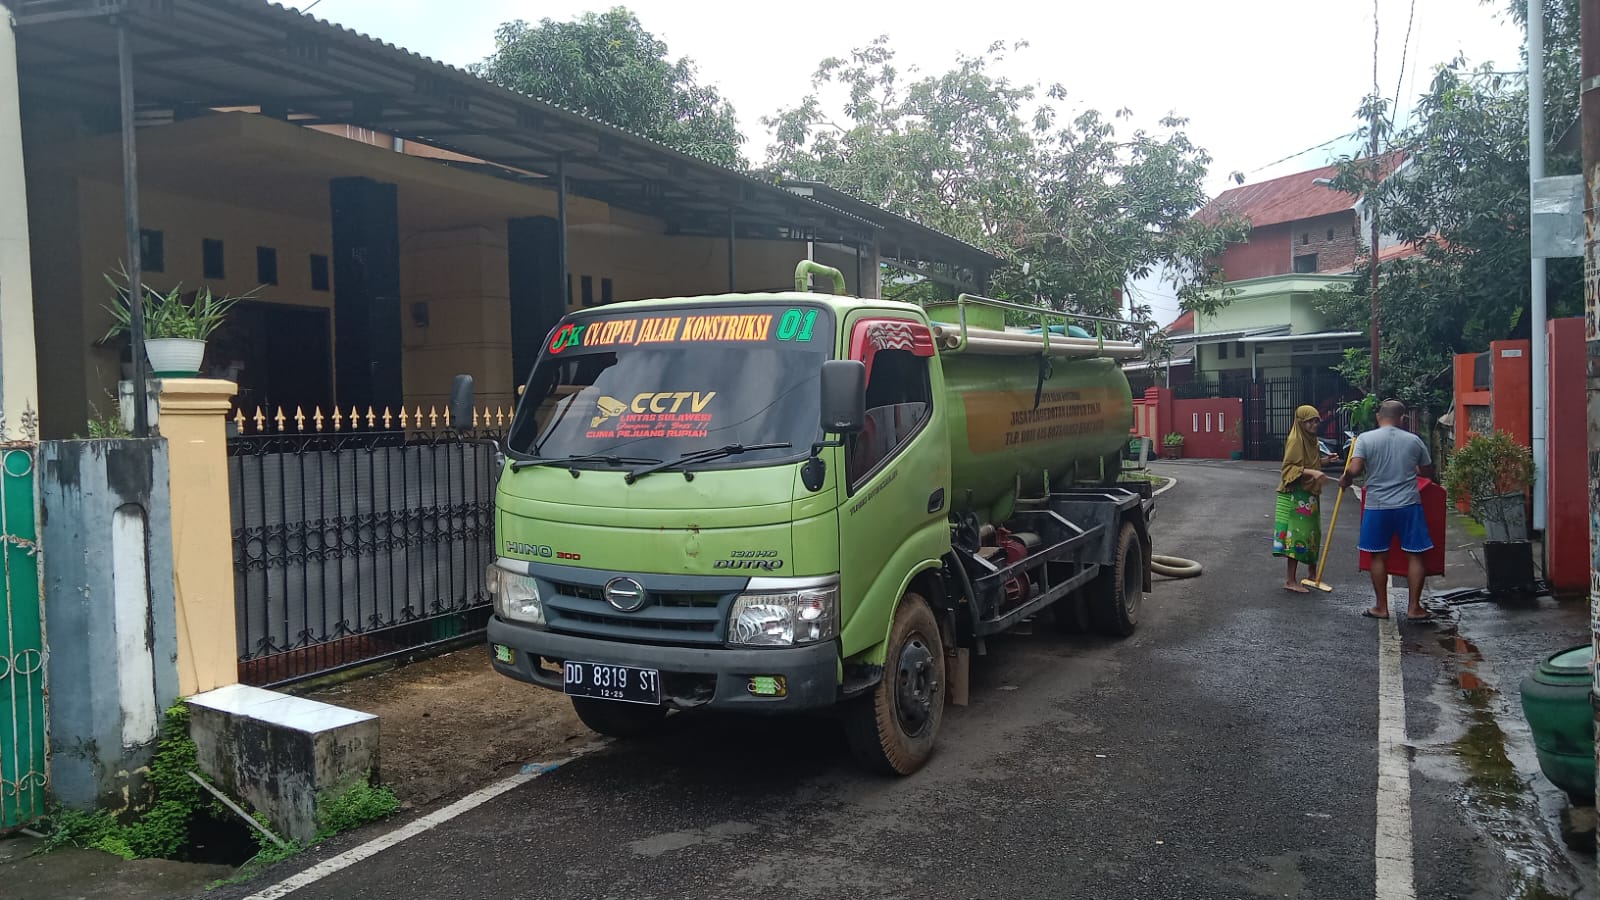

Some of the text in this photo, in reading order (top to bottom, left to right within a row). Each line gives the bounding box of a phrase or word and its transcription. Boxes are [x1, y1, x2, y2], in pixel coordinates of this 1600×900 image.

[634, 317, 679, 345] JALAH
[680, 315, 773, 342] KONSTRUKSI
[775, 308, 819, 342] 01
[631, 391, 716, 414] CCTV
[620, 413, 712, 422] LINTAS SULAWESI
[586, 429, 708, 439] CUMA PEJUANG RUPIAH
[505, 540, 581, 561] HINO 300
[713, 559, 784, 571] DUTRO
[565, 663, 657, 692] DD 8319 ST
